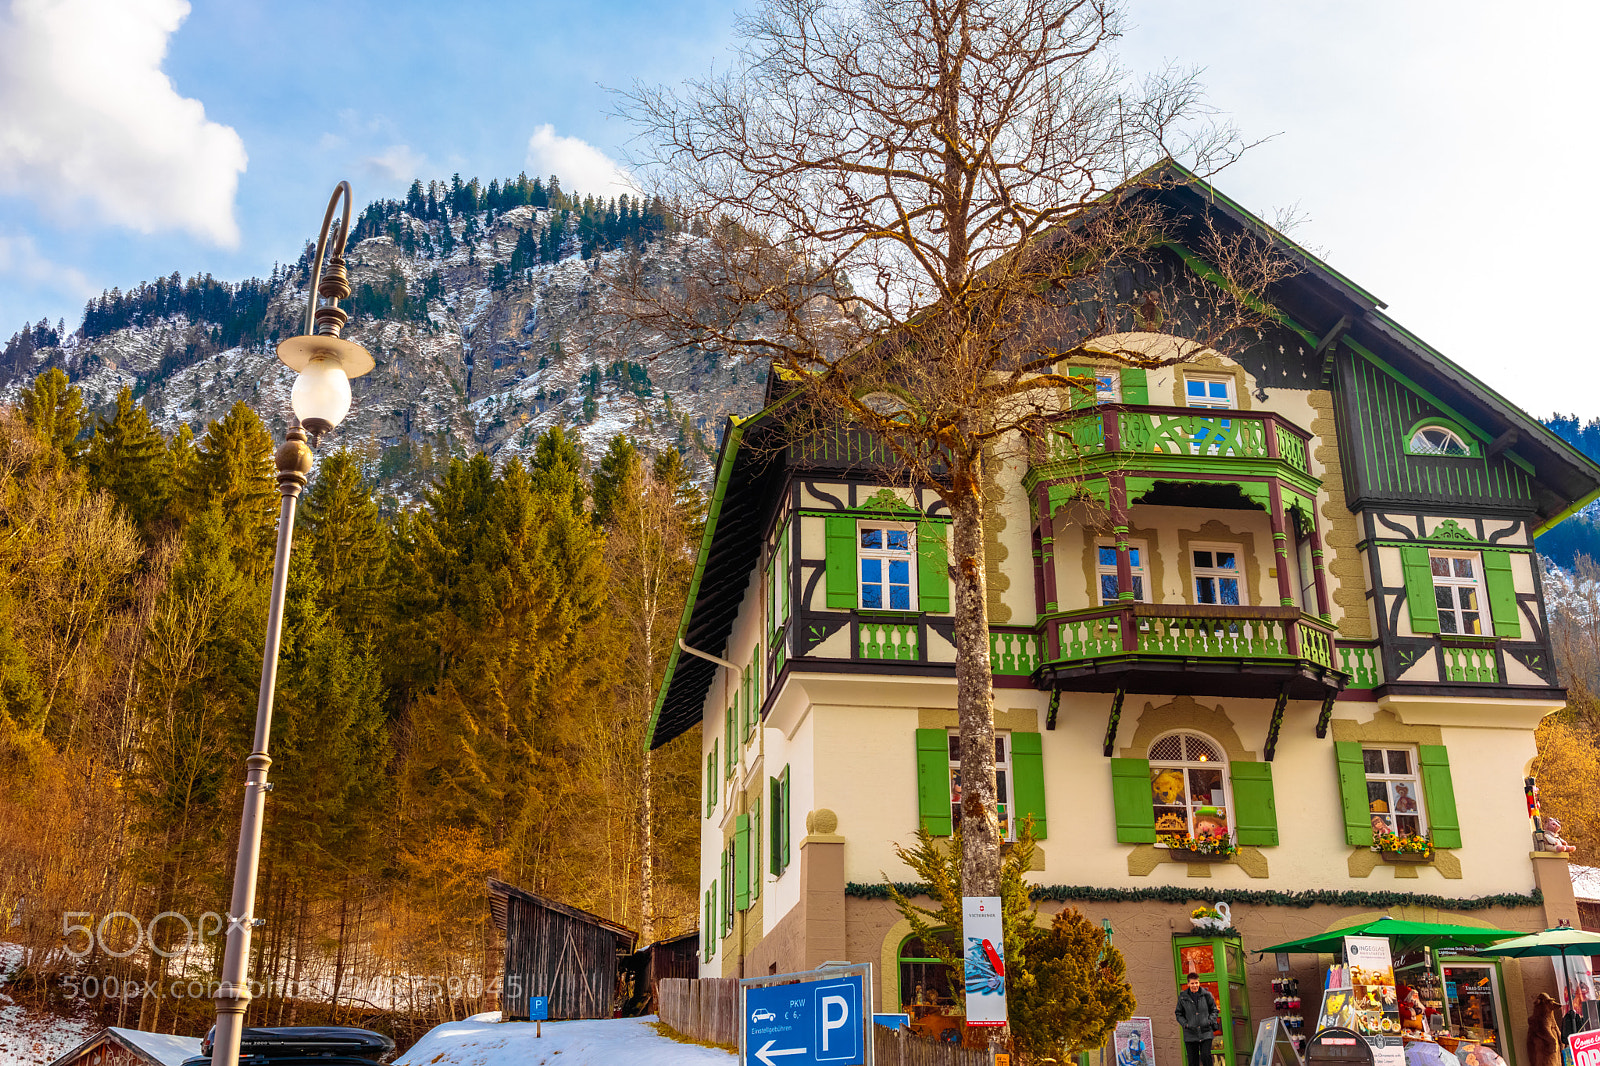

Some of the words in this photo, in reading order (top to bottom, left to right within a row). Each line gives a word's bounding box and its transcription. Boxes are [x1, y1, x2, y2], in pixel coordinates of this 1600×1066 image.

[535, 999, 543, 1010] P
[789, 998, 806, 1008] PKW
[822, 995, 849, 1051] P
[751, 1025, 793, 1035] Einstellgebühren
[1574, 1037, 1594, 1050] Come
[1577, 1048, 1600, 1066] OP
